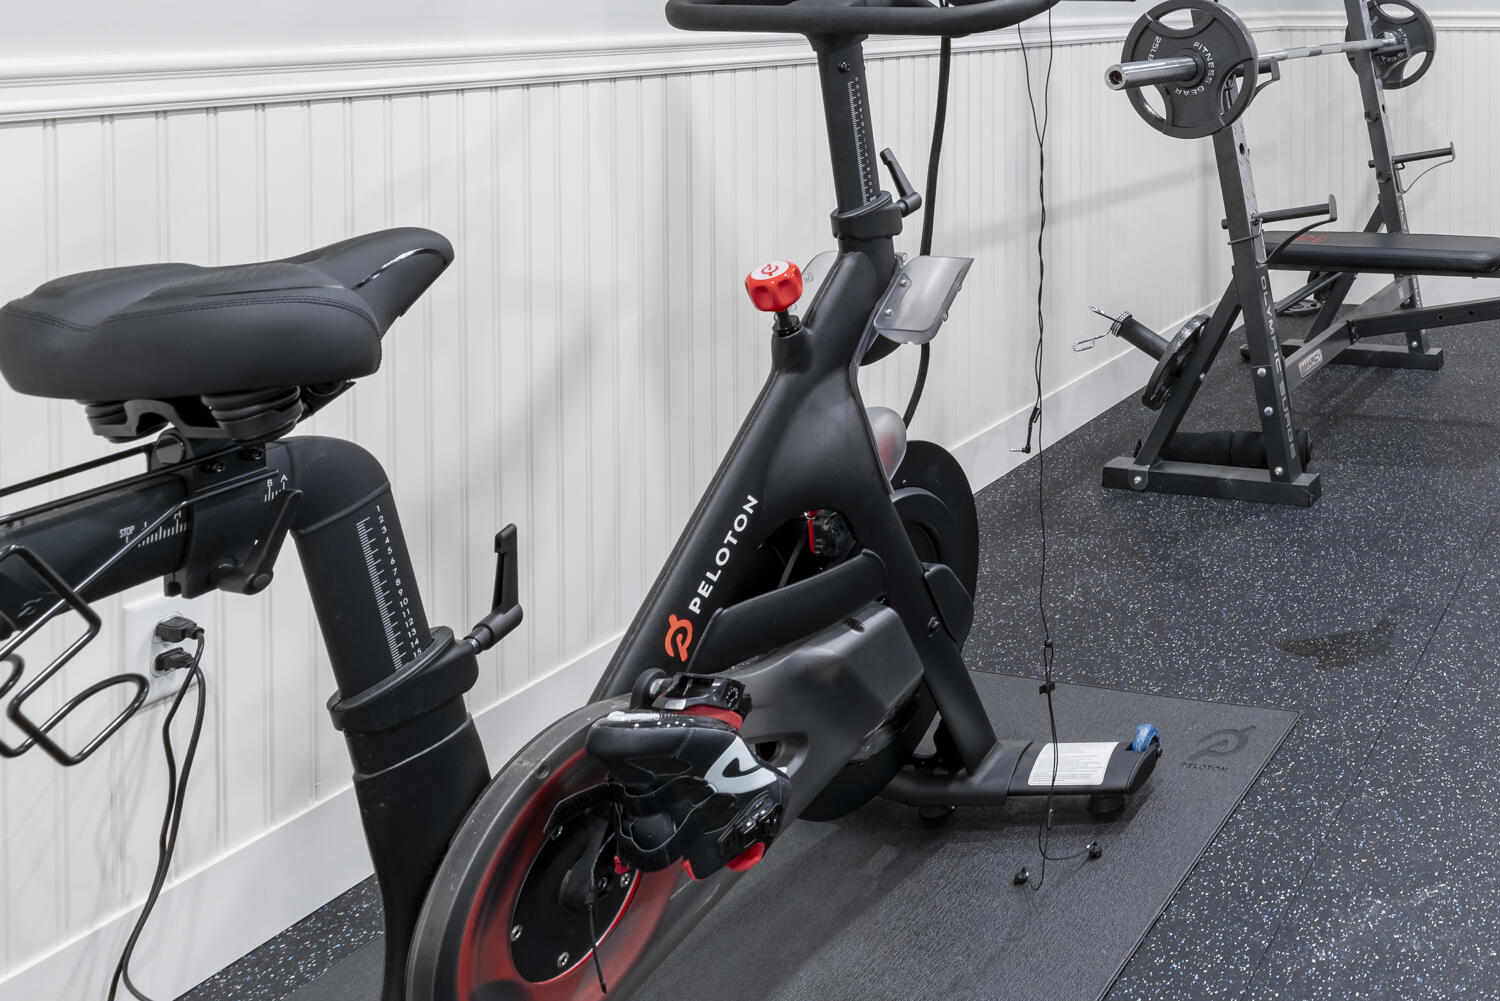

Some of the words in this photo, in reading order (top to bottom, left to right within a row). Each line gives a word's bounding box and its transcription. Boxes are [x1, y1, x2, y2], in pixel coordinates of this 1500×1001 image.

[1148, 36, 1161, 60] 25LB
[1193, 41, 1215, 84] FITNESS
[1175, 85, 1205, 96] GEAR
[1261, 276, 1282, 373] OLYMPIC
[267, 479, 273, 487] B
[280, 474, 288, 482] A
[119, 525, 135, 539] STOP
[688, 494, 759, 615] PELOTON
[400, 597, 408, 608] 10
[402, 608, 411, 617] 11
[405, 618, 414, 628] 12
[407, 628, 417, 638] 13
[411, 638, 419, 648] 14
